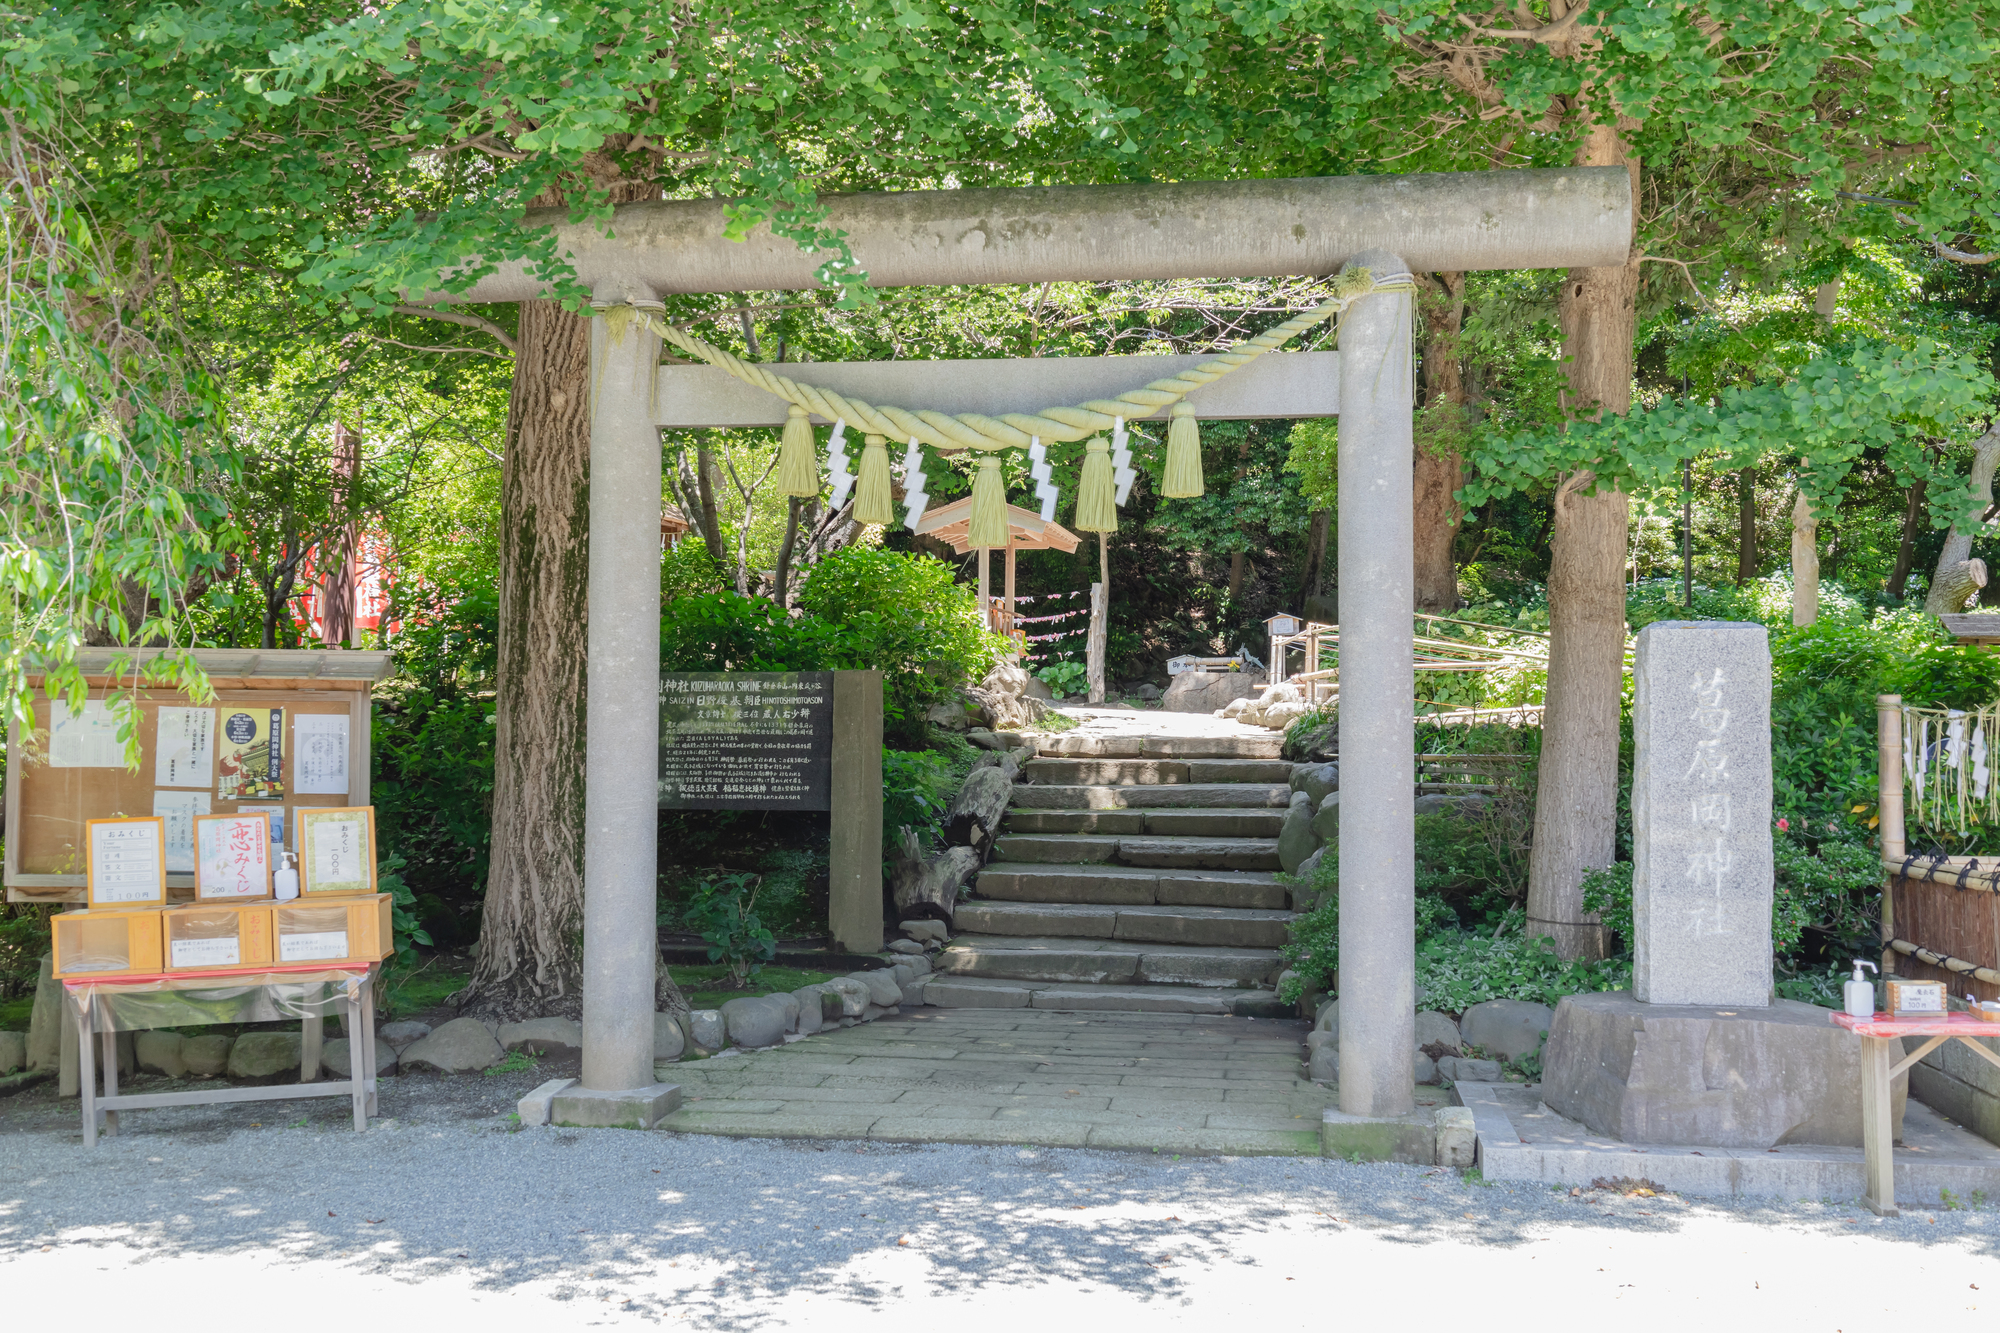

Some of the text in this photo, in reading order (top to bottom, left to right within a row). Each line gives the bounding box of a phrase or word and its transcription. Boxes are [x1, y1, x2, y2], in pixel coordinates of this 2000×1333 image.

[669, 697, 694, 705] SAIZIN
[690, 680, 734, 692] KUZUHARAOKA
[736, 680, 762, 692] SHRINE
[271, 722, 279, 778] 葛原岡神社 例大祭
[1684, 667, 1733, 938] 葛原岡神社
[108, 830, 145, 838] おみくじ
[180, 803, 188, 849] マスクの着用を
[341, 825, 349, 853] おみくじ
[228, 822, 254, 893] 恋みくじ
[331, 848, 339, 875] 一〇〇円
[249, 915, 261, 959] おみくじ
